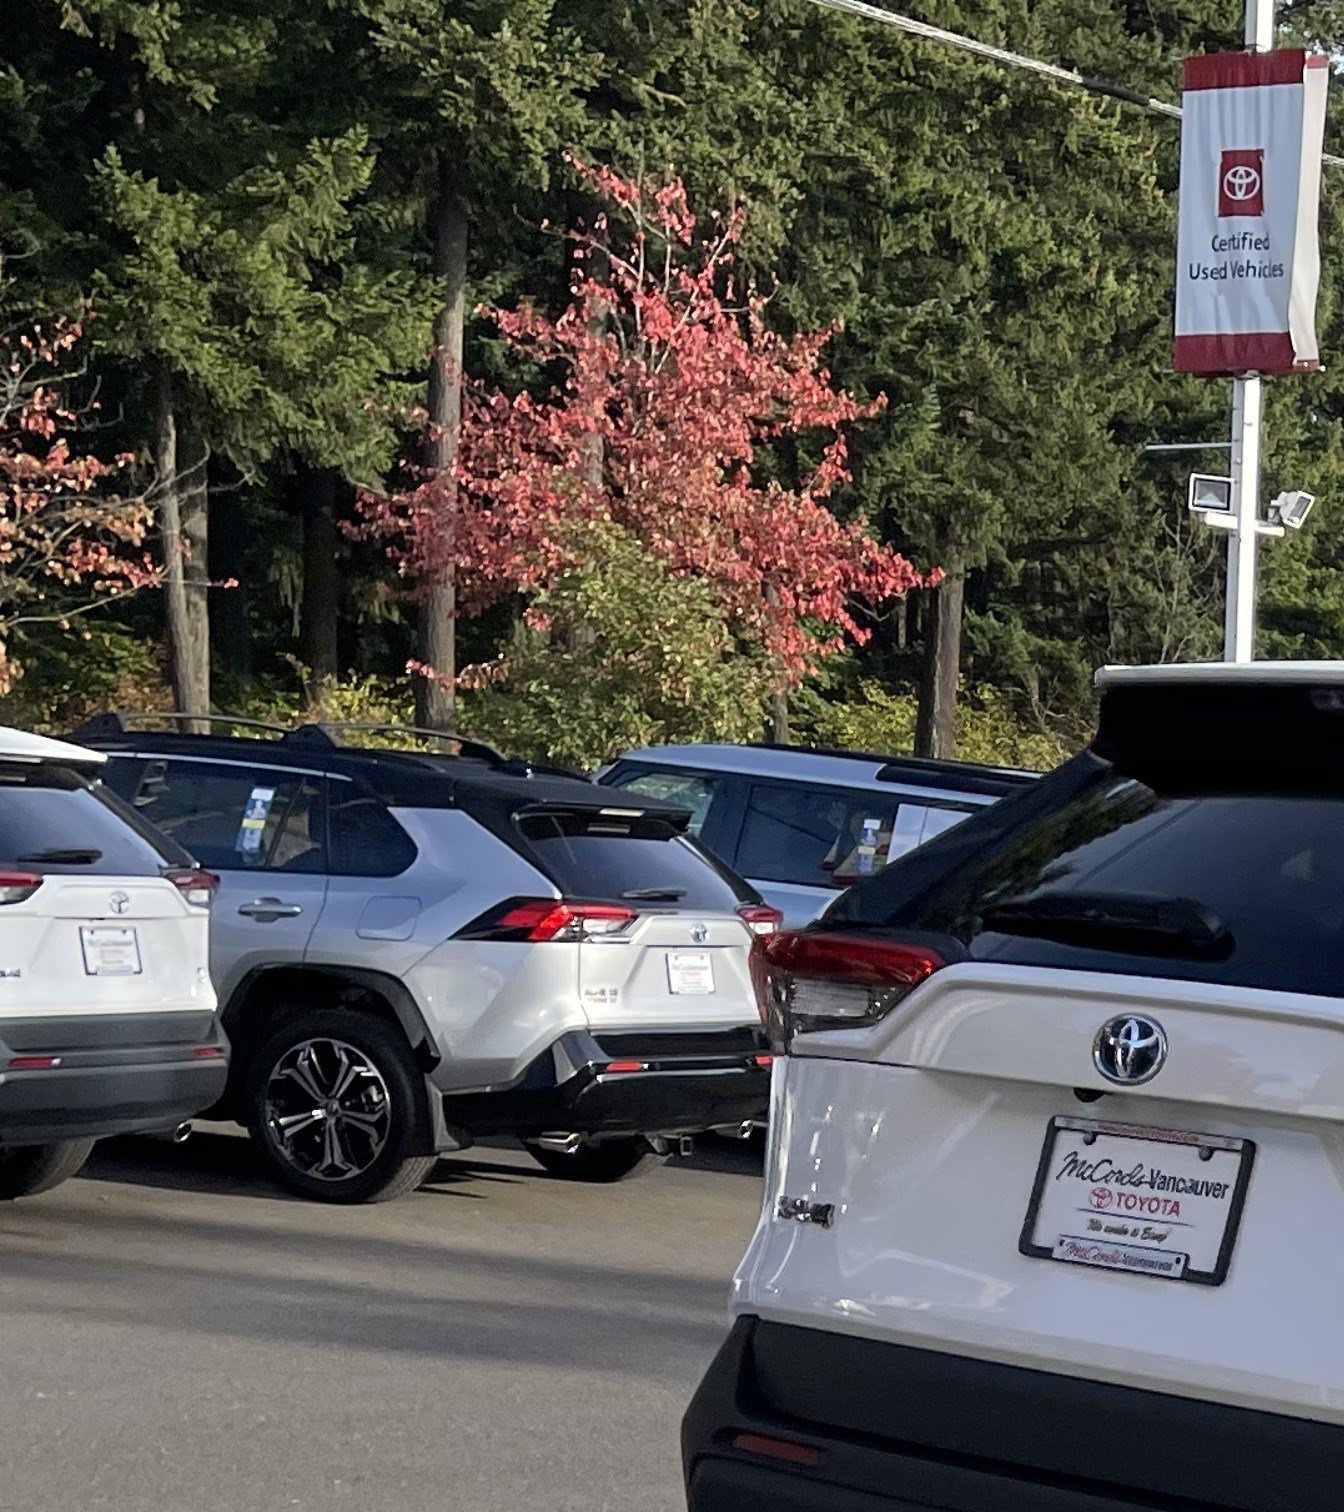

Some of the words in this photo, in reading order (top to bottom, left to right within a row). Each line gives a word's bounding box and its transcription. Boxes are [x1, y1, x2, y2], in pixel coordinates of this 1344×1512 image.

[1211, 231, 1270, 252] Certified
[1189, 262, 1227, 280] Used
[1229, 260, 1284, 279] Vehicles
[1116, 1191, 1181, 1217] TOYOTA
